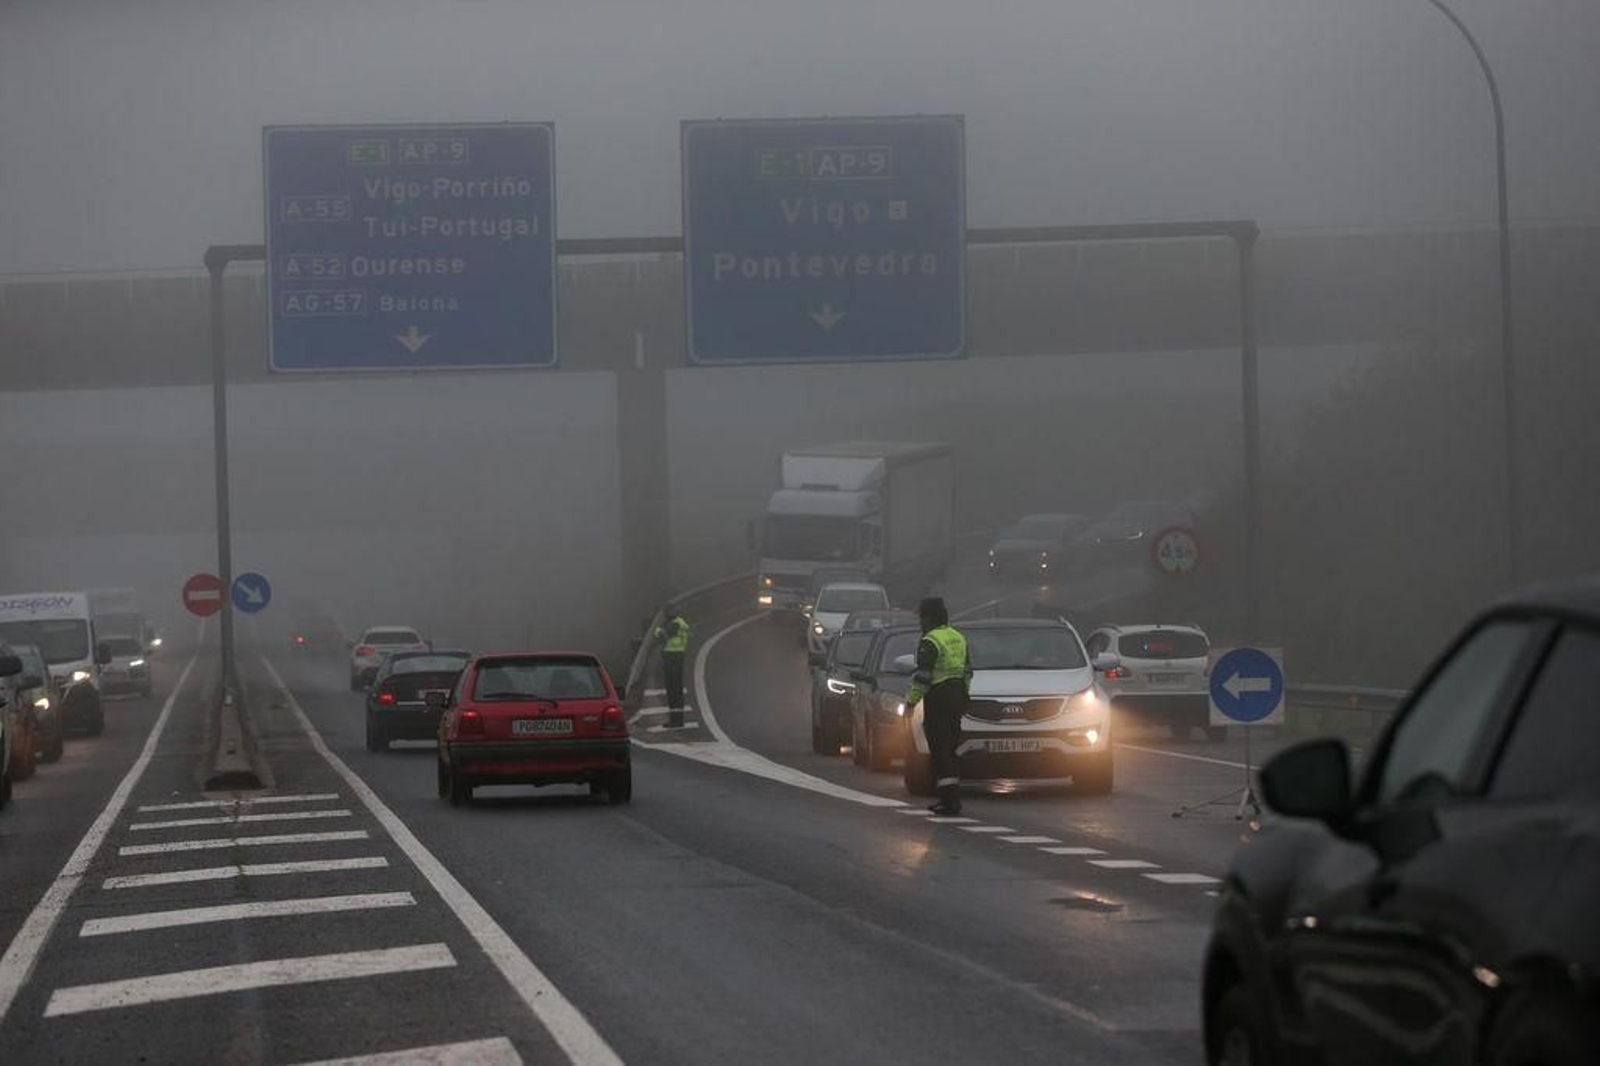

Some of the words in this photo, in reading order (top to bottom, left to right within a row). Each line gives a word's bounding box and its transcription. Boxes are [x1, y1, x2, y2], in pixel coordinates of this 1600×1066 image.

[403, 141, 466, 161] AP-9
[818, 151, 886, 176] AP-9
[780, 197, 871, 229] Vigo
[363, 215, 538, 241] Tui-Portugal
[285, 257, 343, 277] A-52
[351, 255, 467, 277] Ourense
[712, 249, 938, 280] Pontevedra
[285, 293, 363, 313] AG-57
